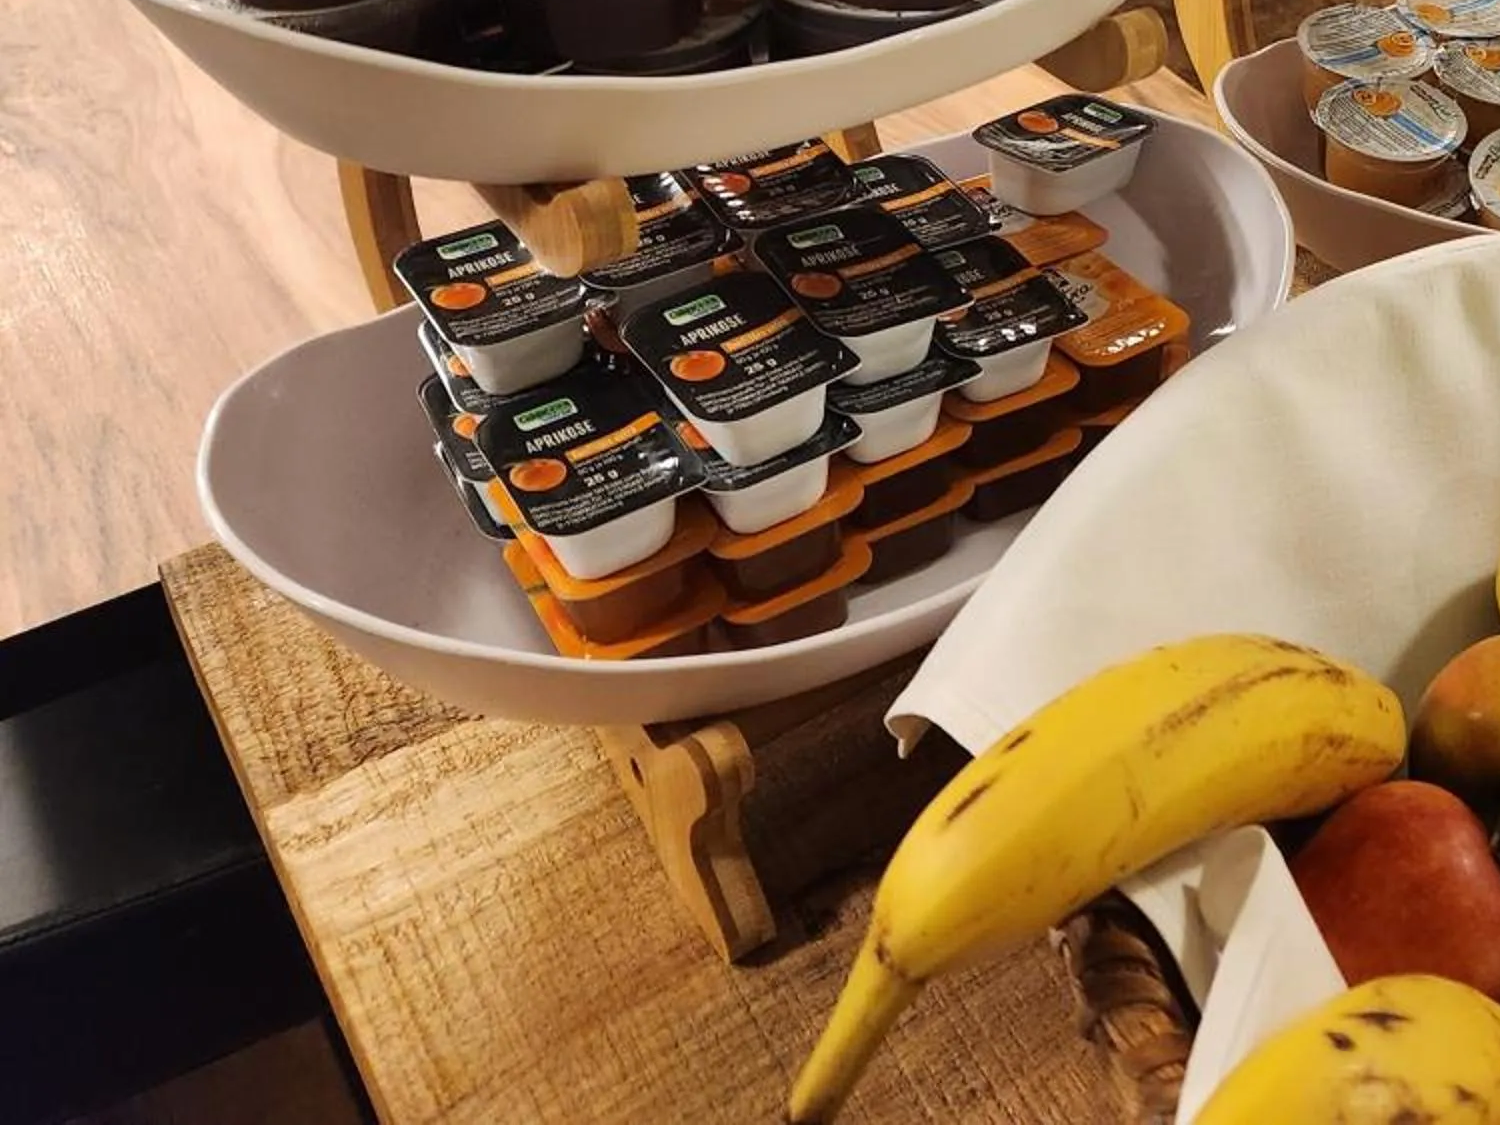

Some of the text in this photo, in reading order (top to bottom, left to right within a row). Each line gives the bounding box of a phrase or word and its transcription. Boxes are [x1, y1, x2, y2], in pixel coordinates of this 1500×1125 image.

[448, 250, 518, 280] APRIKOSE
[678, 312, 748, 348] APRIKOSE
[744, 362, 765, 375] 25
[524, 419, 598, 455] APRIKOSE
[583, 468, 619, 487] 25 g
